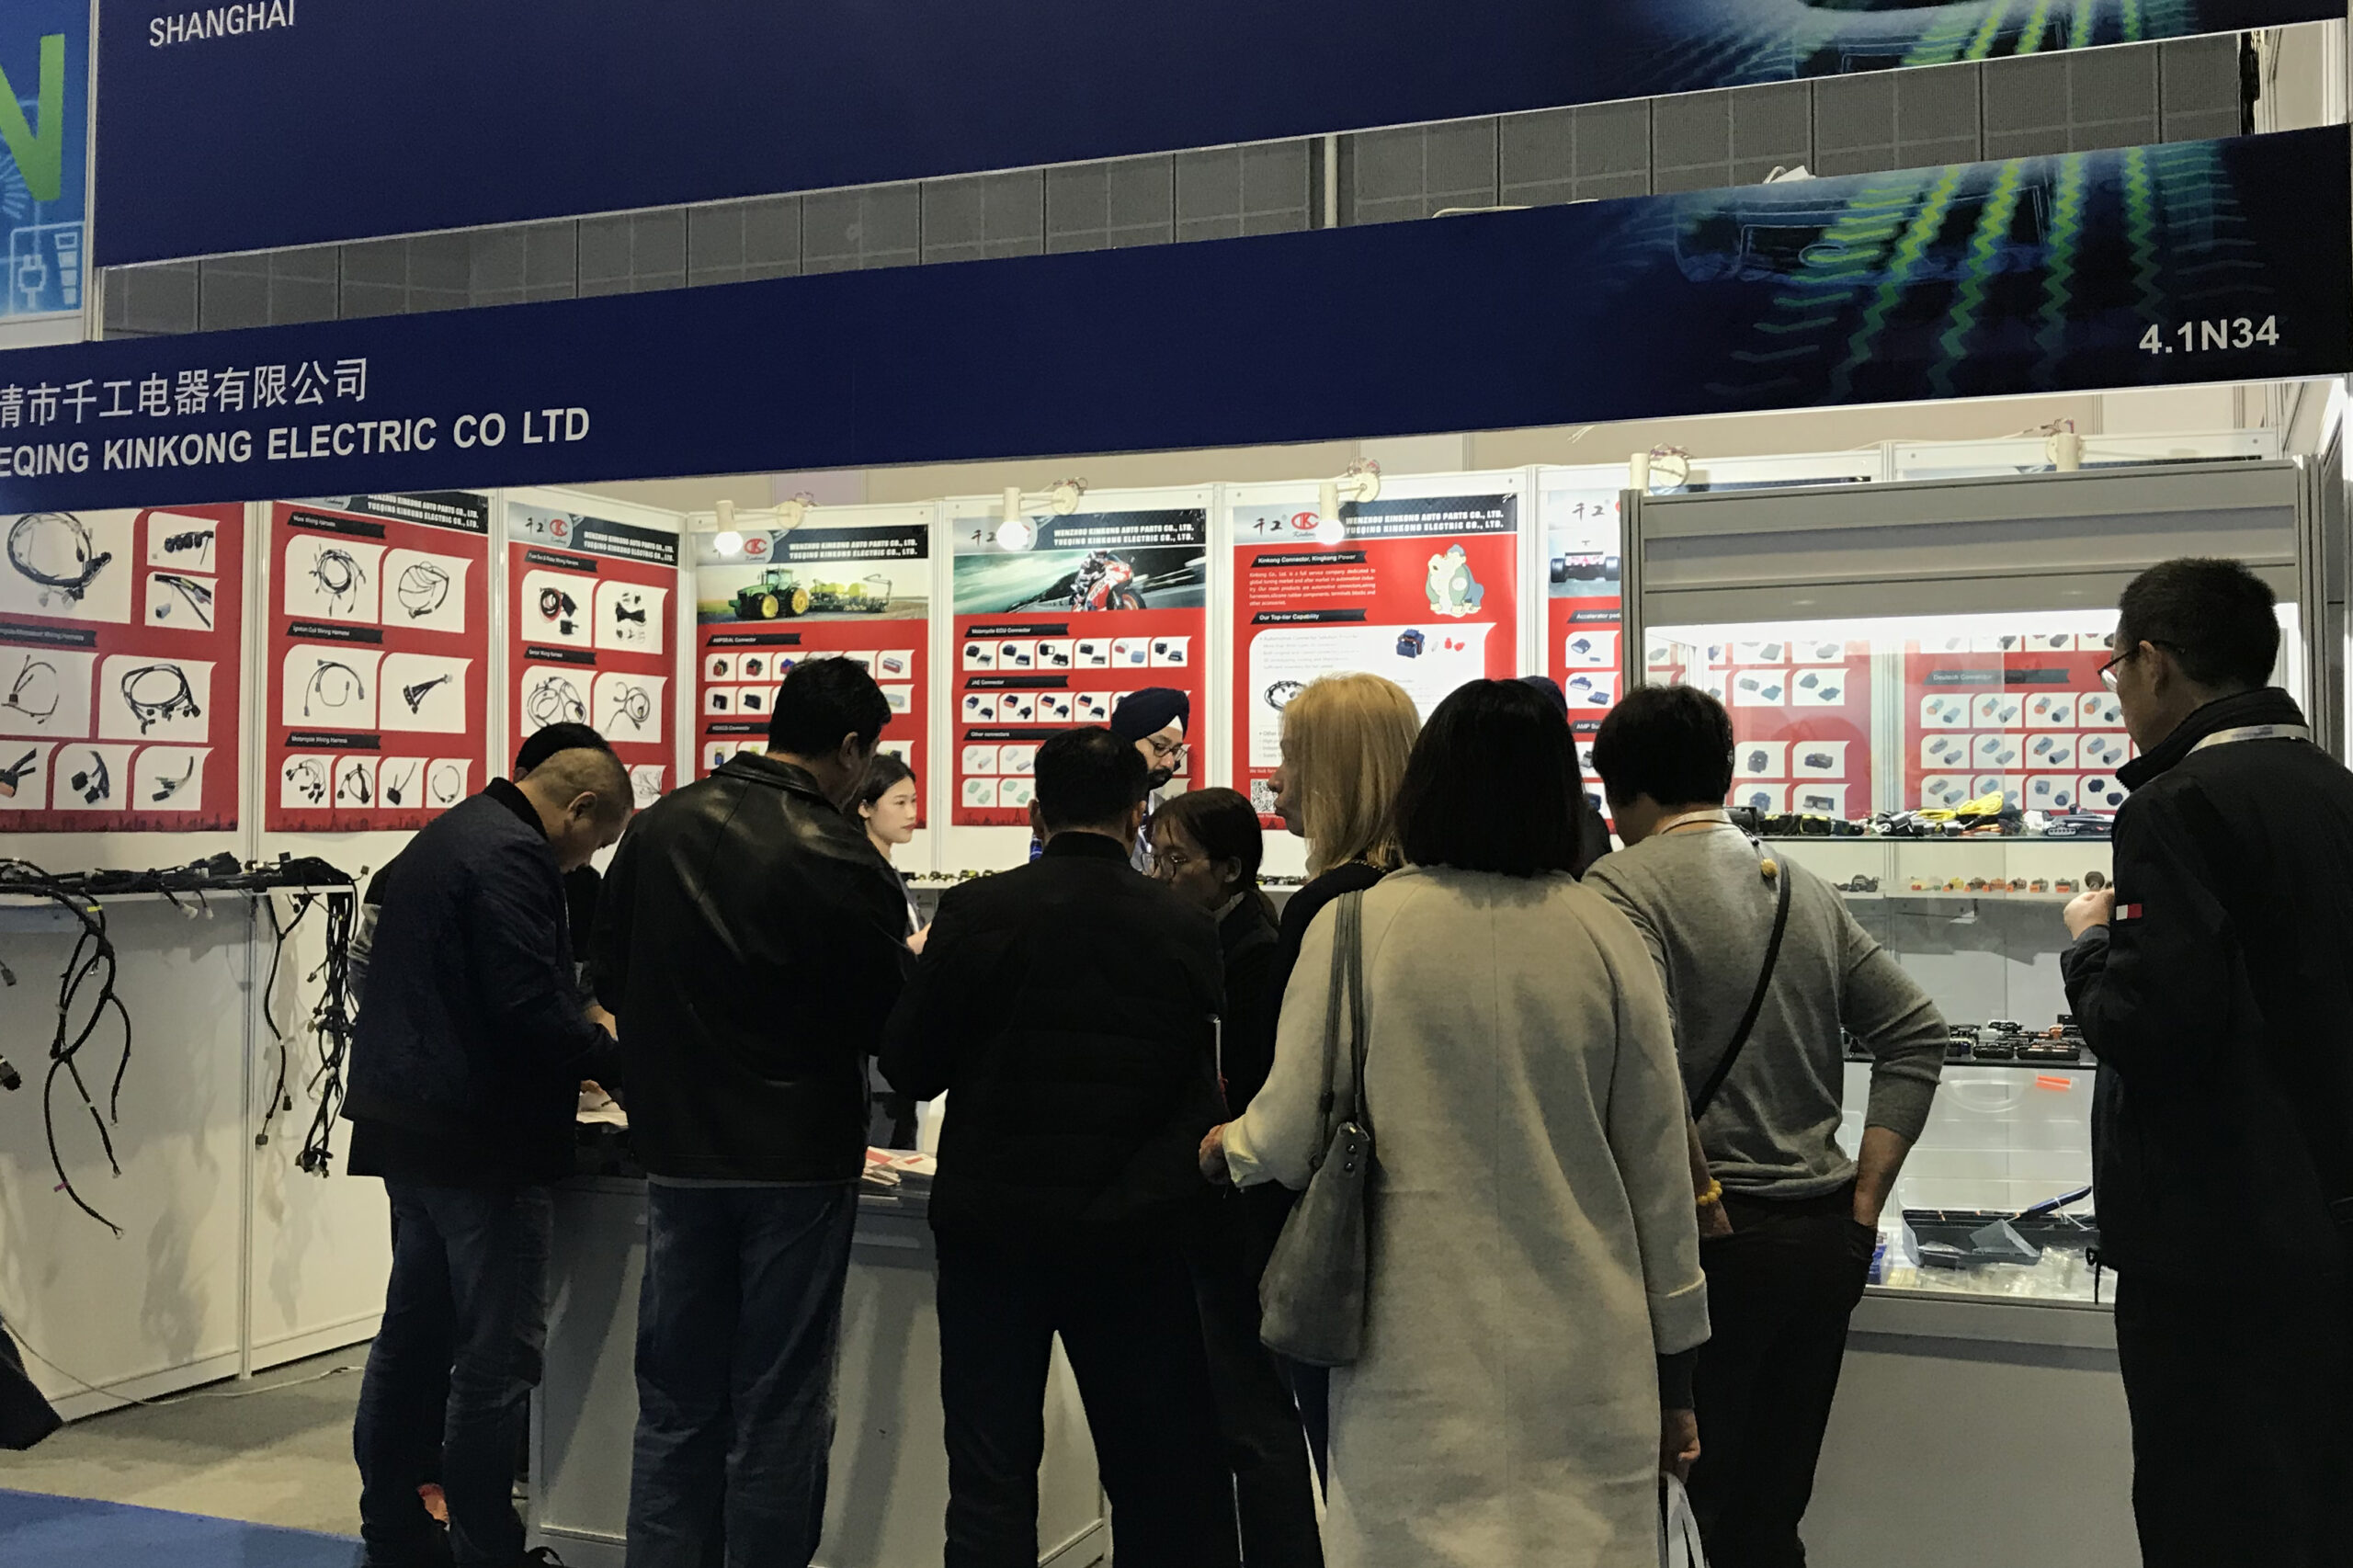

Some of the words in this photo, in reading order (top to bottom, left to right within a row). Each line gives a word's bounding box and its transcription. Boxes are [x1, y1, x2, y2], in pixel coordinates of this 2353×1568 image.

[149, 0, 295, 47] SHANGHAI
[2139, 314, 2279, 354] 4.1N34
[104, 430, 252, 471] KINKONG
[267, 417, 437, 460] ELECTRIC
[454, 413, 506, 449] CO
[523, 407, 589, 444] LTD
[1121, 526, 1140, 534] AUTO
[1141, 525, 1163, 533] PARTS
[1421, 513, 1441, 521] AUTO
[1442, 512, 1468, 520] PARTS
